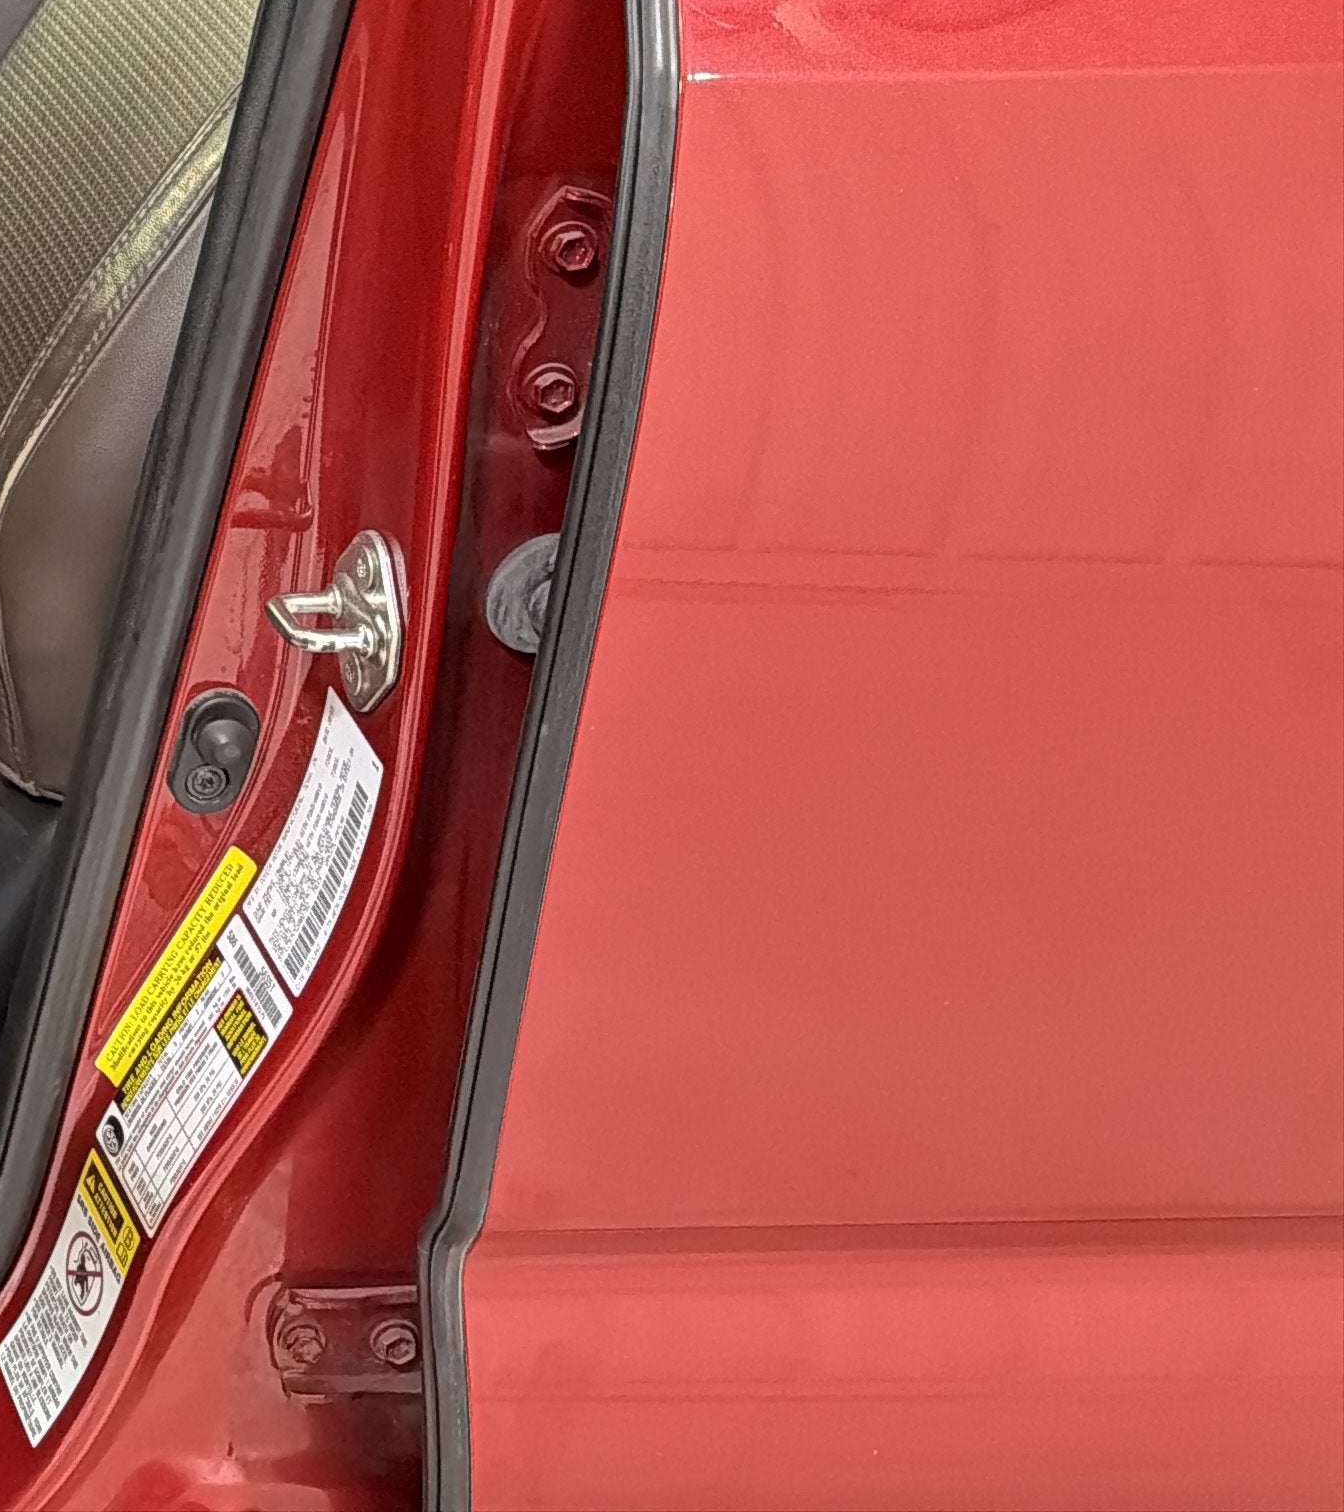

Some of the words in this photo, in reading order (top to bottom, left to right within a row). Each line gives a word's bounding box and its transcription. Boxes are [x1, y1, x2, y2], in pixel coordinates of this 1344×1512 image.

[210, 880, 234, 913] original
[229, 862, 244, 882] load
[104, 1019, 134, 1062] CAUTION:
[130, 993, 150, 1021] LOAD
[146, 948, 178, 996] CARRYING
[175, 904, 207, 951] CAPACITY
[204, 862, 234, 906] REDUCED
[133, 1052, 149, 1076] AND
